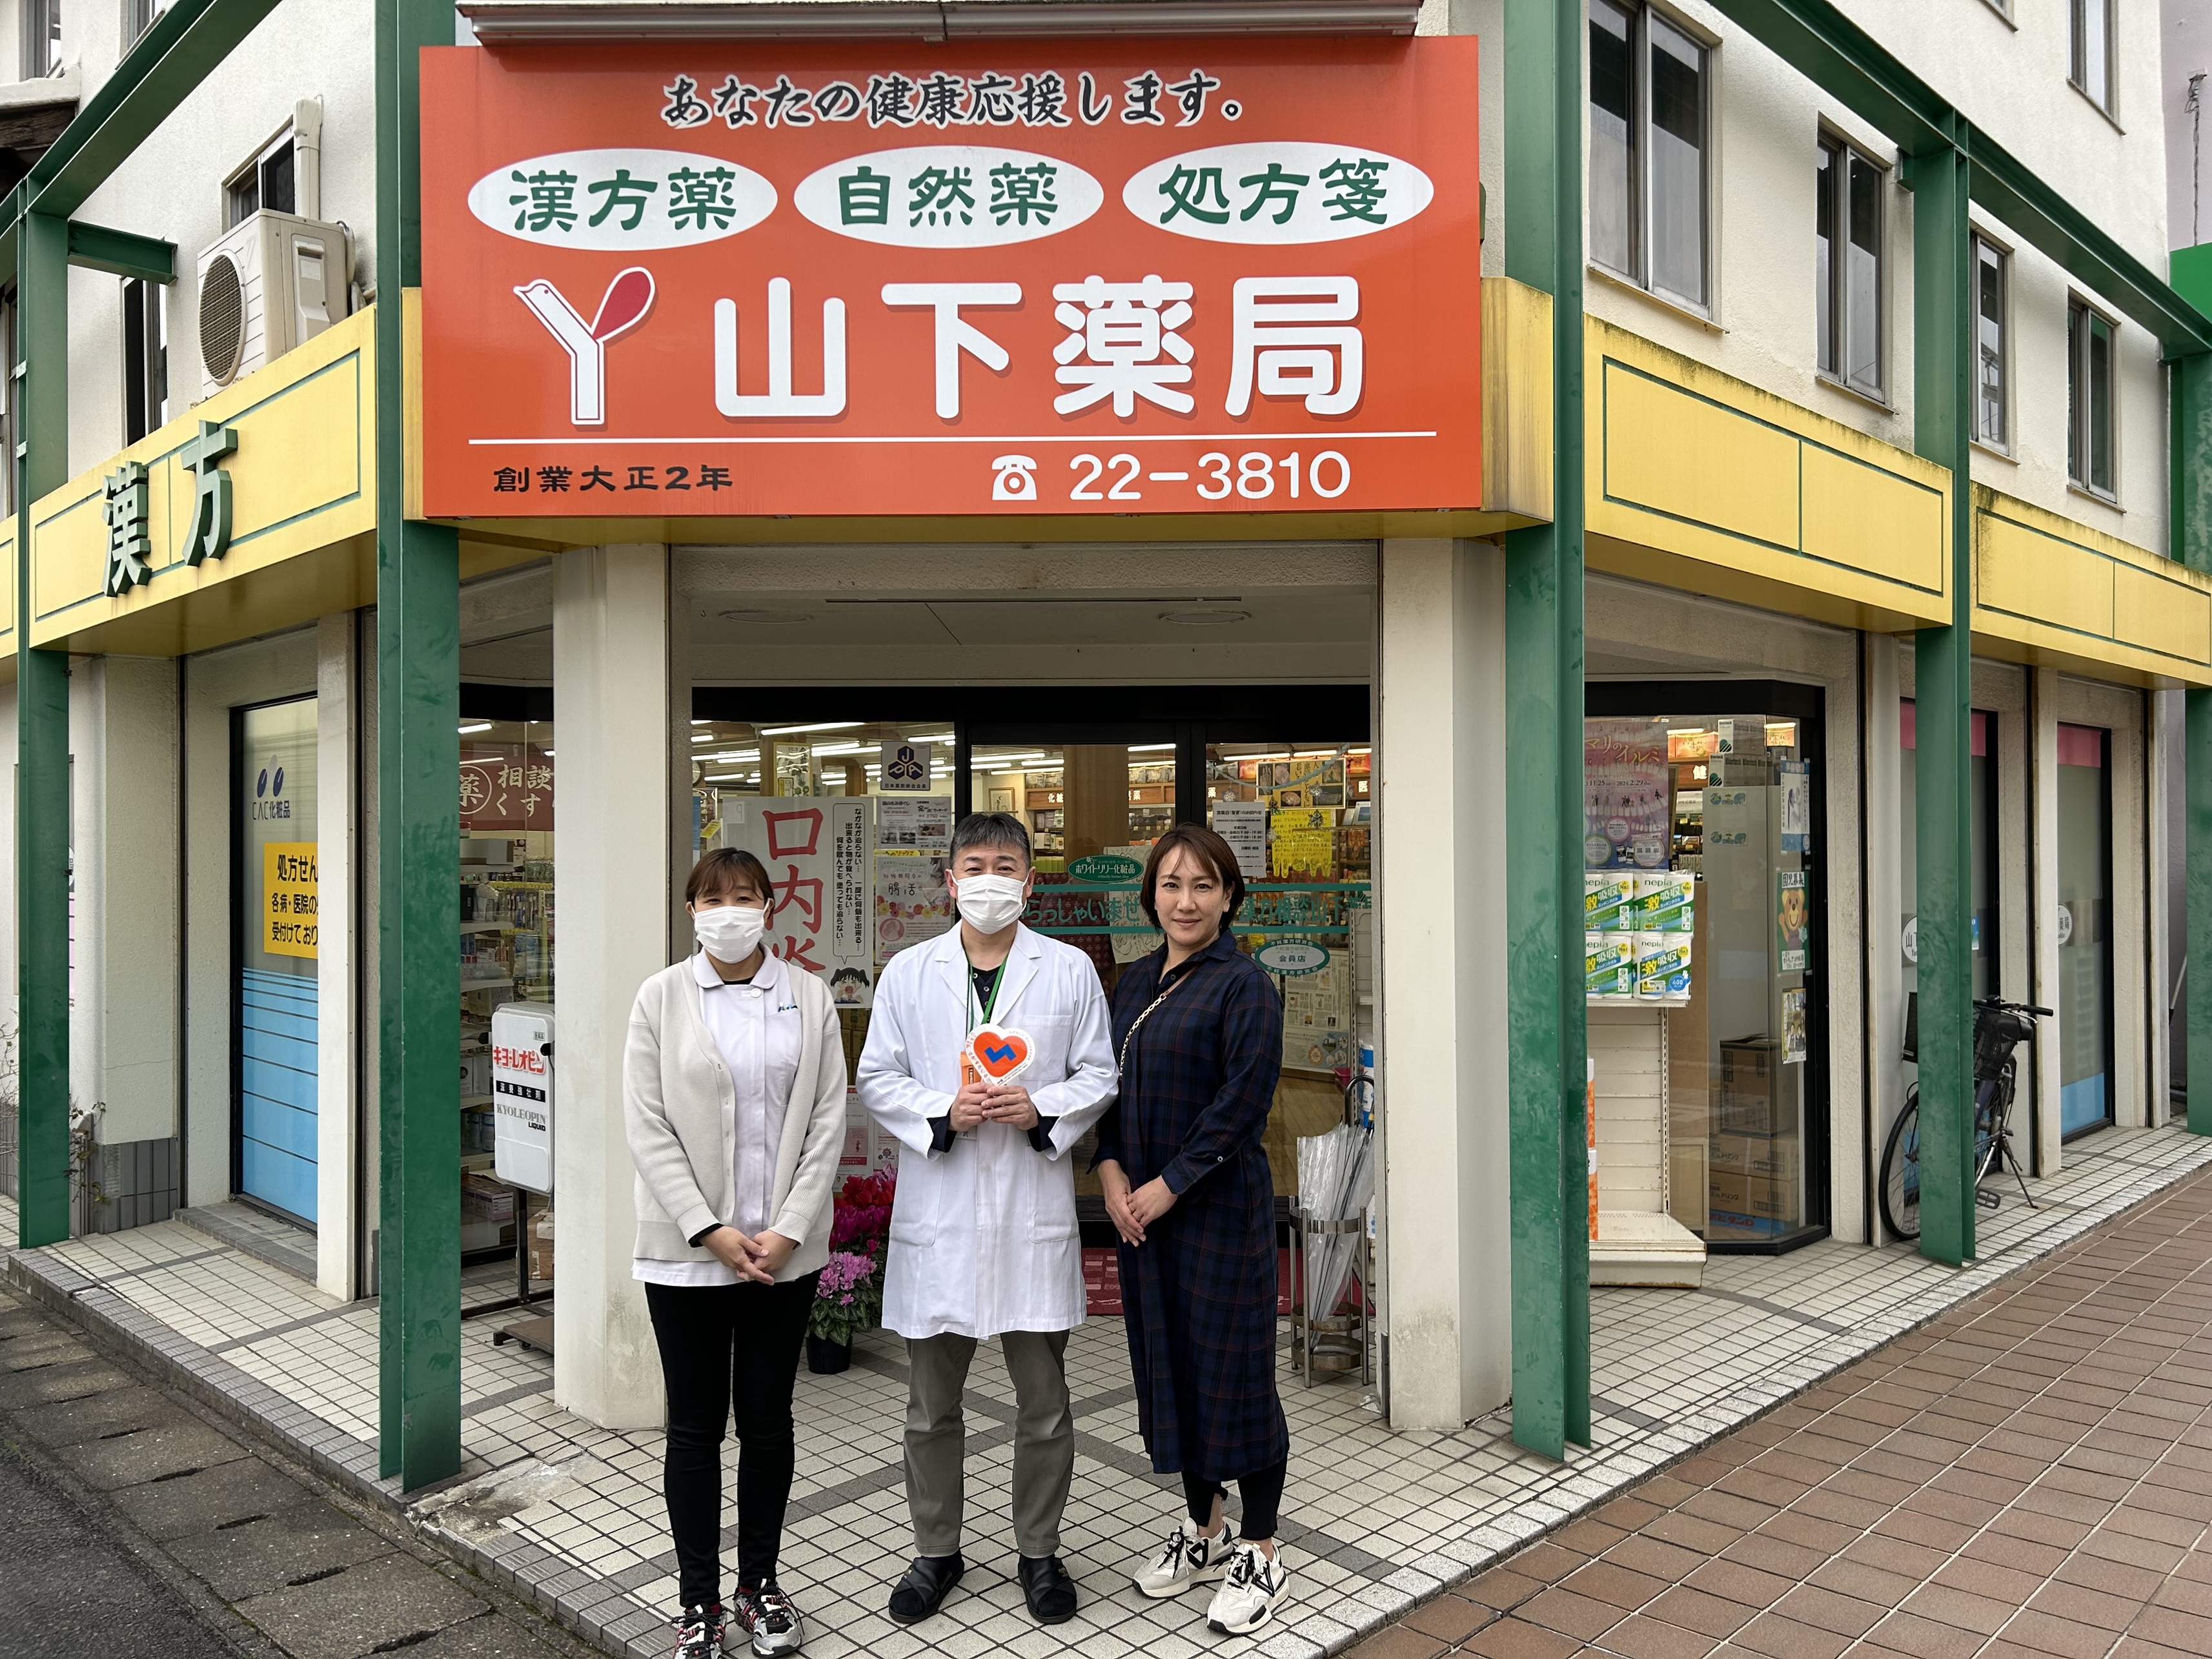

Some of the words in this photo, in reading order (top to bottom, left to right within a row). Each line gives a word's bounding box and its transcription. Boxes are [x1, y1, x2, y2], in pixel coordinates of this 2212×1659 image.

[661, 69, 1243, 128] あなたの健康応援します。
[509, 167, 738, 233] 漢方薬
[838, 161, 1059, 228] 自然薬
[1159, 158, 1390, 225] 処方箋
[714, 275, 1368, 420] 山下薬局
[493, 464, 733, 493] 創業大正2年
[1069, 452, 1351, 501] 22-3810
[101, 420, 238, 598] 漢方
[498, 764, 552, 791] 相談
[496, 793, 554, 817] くす
[1128, 791, 1141, 801] 薬
[278, 854, 318, 883] 処方せん
[1644, 879, 1672, 887] nepia
[888, 882, 917, 896] 腸活
[272, 893, 318, 915] 各病・医院の
[496, 1103, 546, 1125] KYOLEOPIN
[528, 1121, 546, 1132] LIQUID
